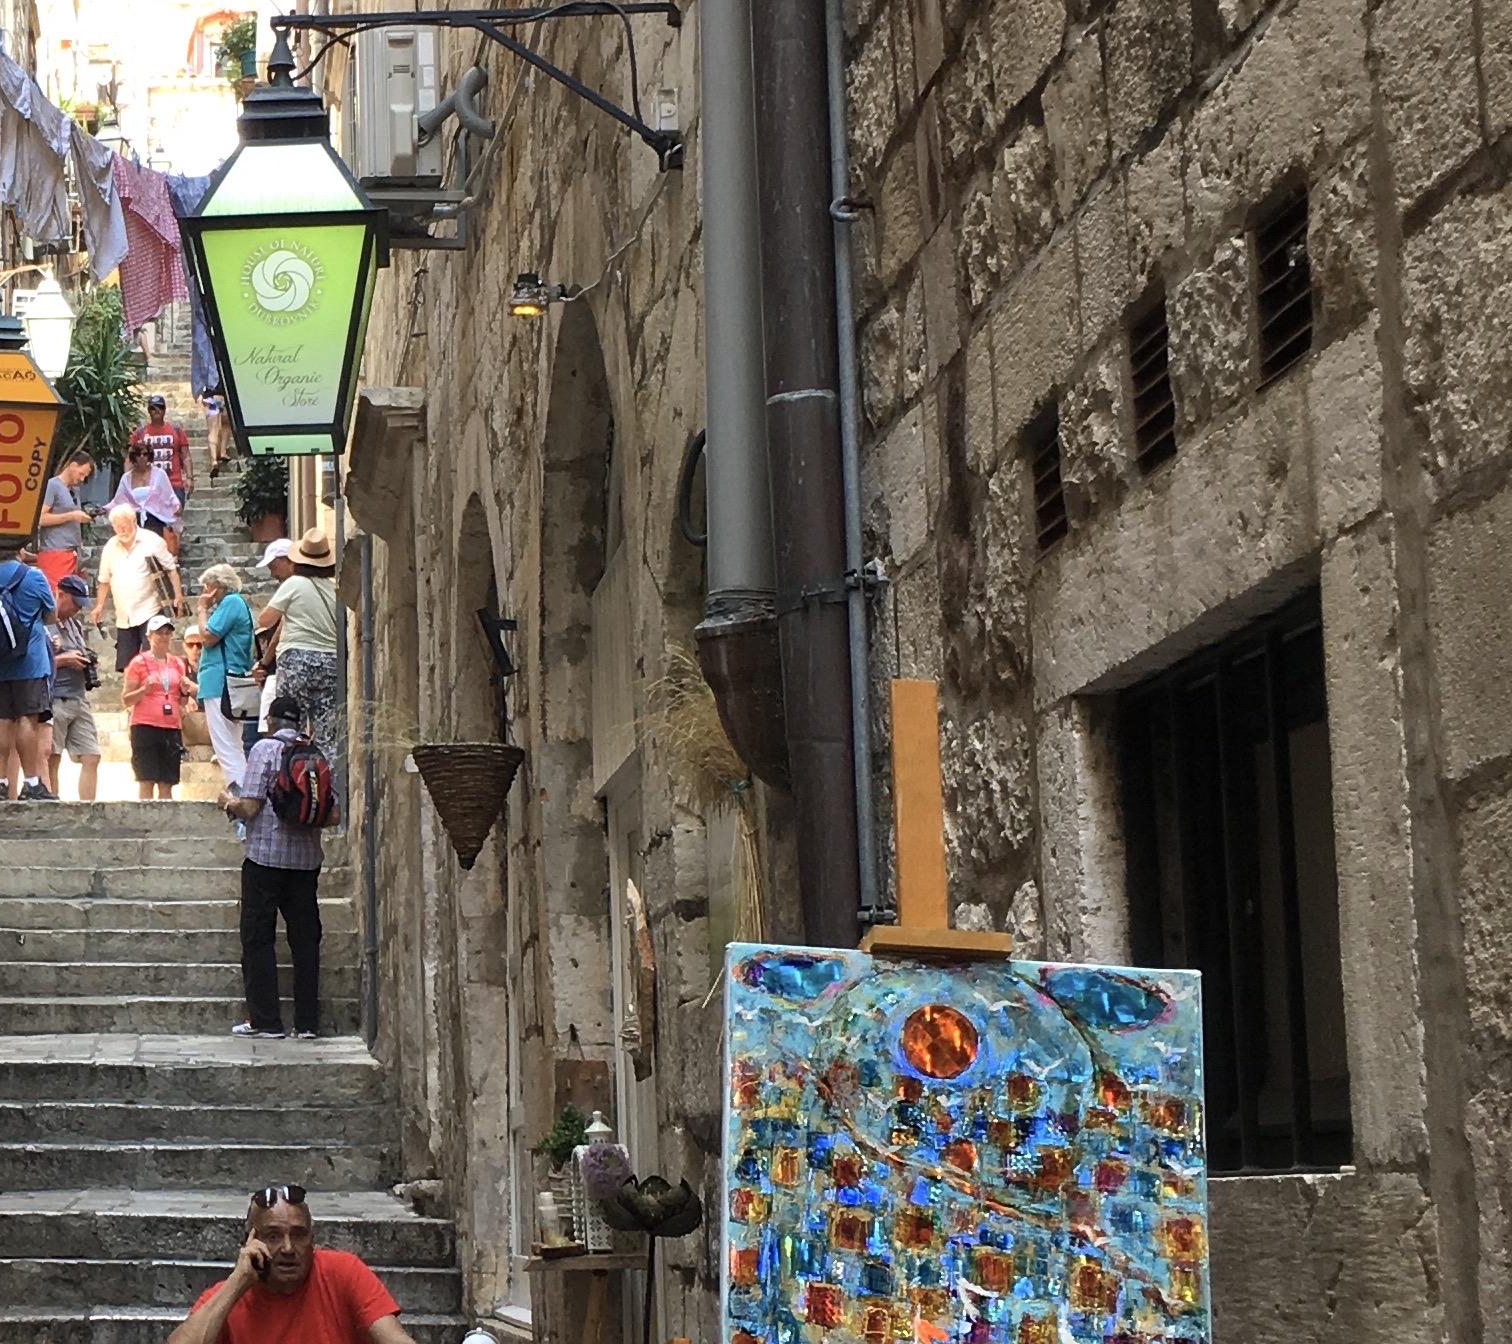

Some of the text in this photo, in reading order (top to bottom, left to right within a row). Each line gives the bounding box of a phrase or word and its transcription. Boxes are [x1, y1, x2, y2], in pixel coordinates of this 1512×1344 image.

[240, 239, 325, 286] HOUSE OF NATURE
[248, 300, 320, 326] DUBROVNIK
[234, 344, 304, 365] Natural
[255, 365, 322, 392] Organic
[282, 388, 322, 407] Store
[24, 436, 47, 491] COPY
